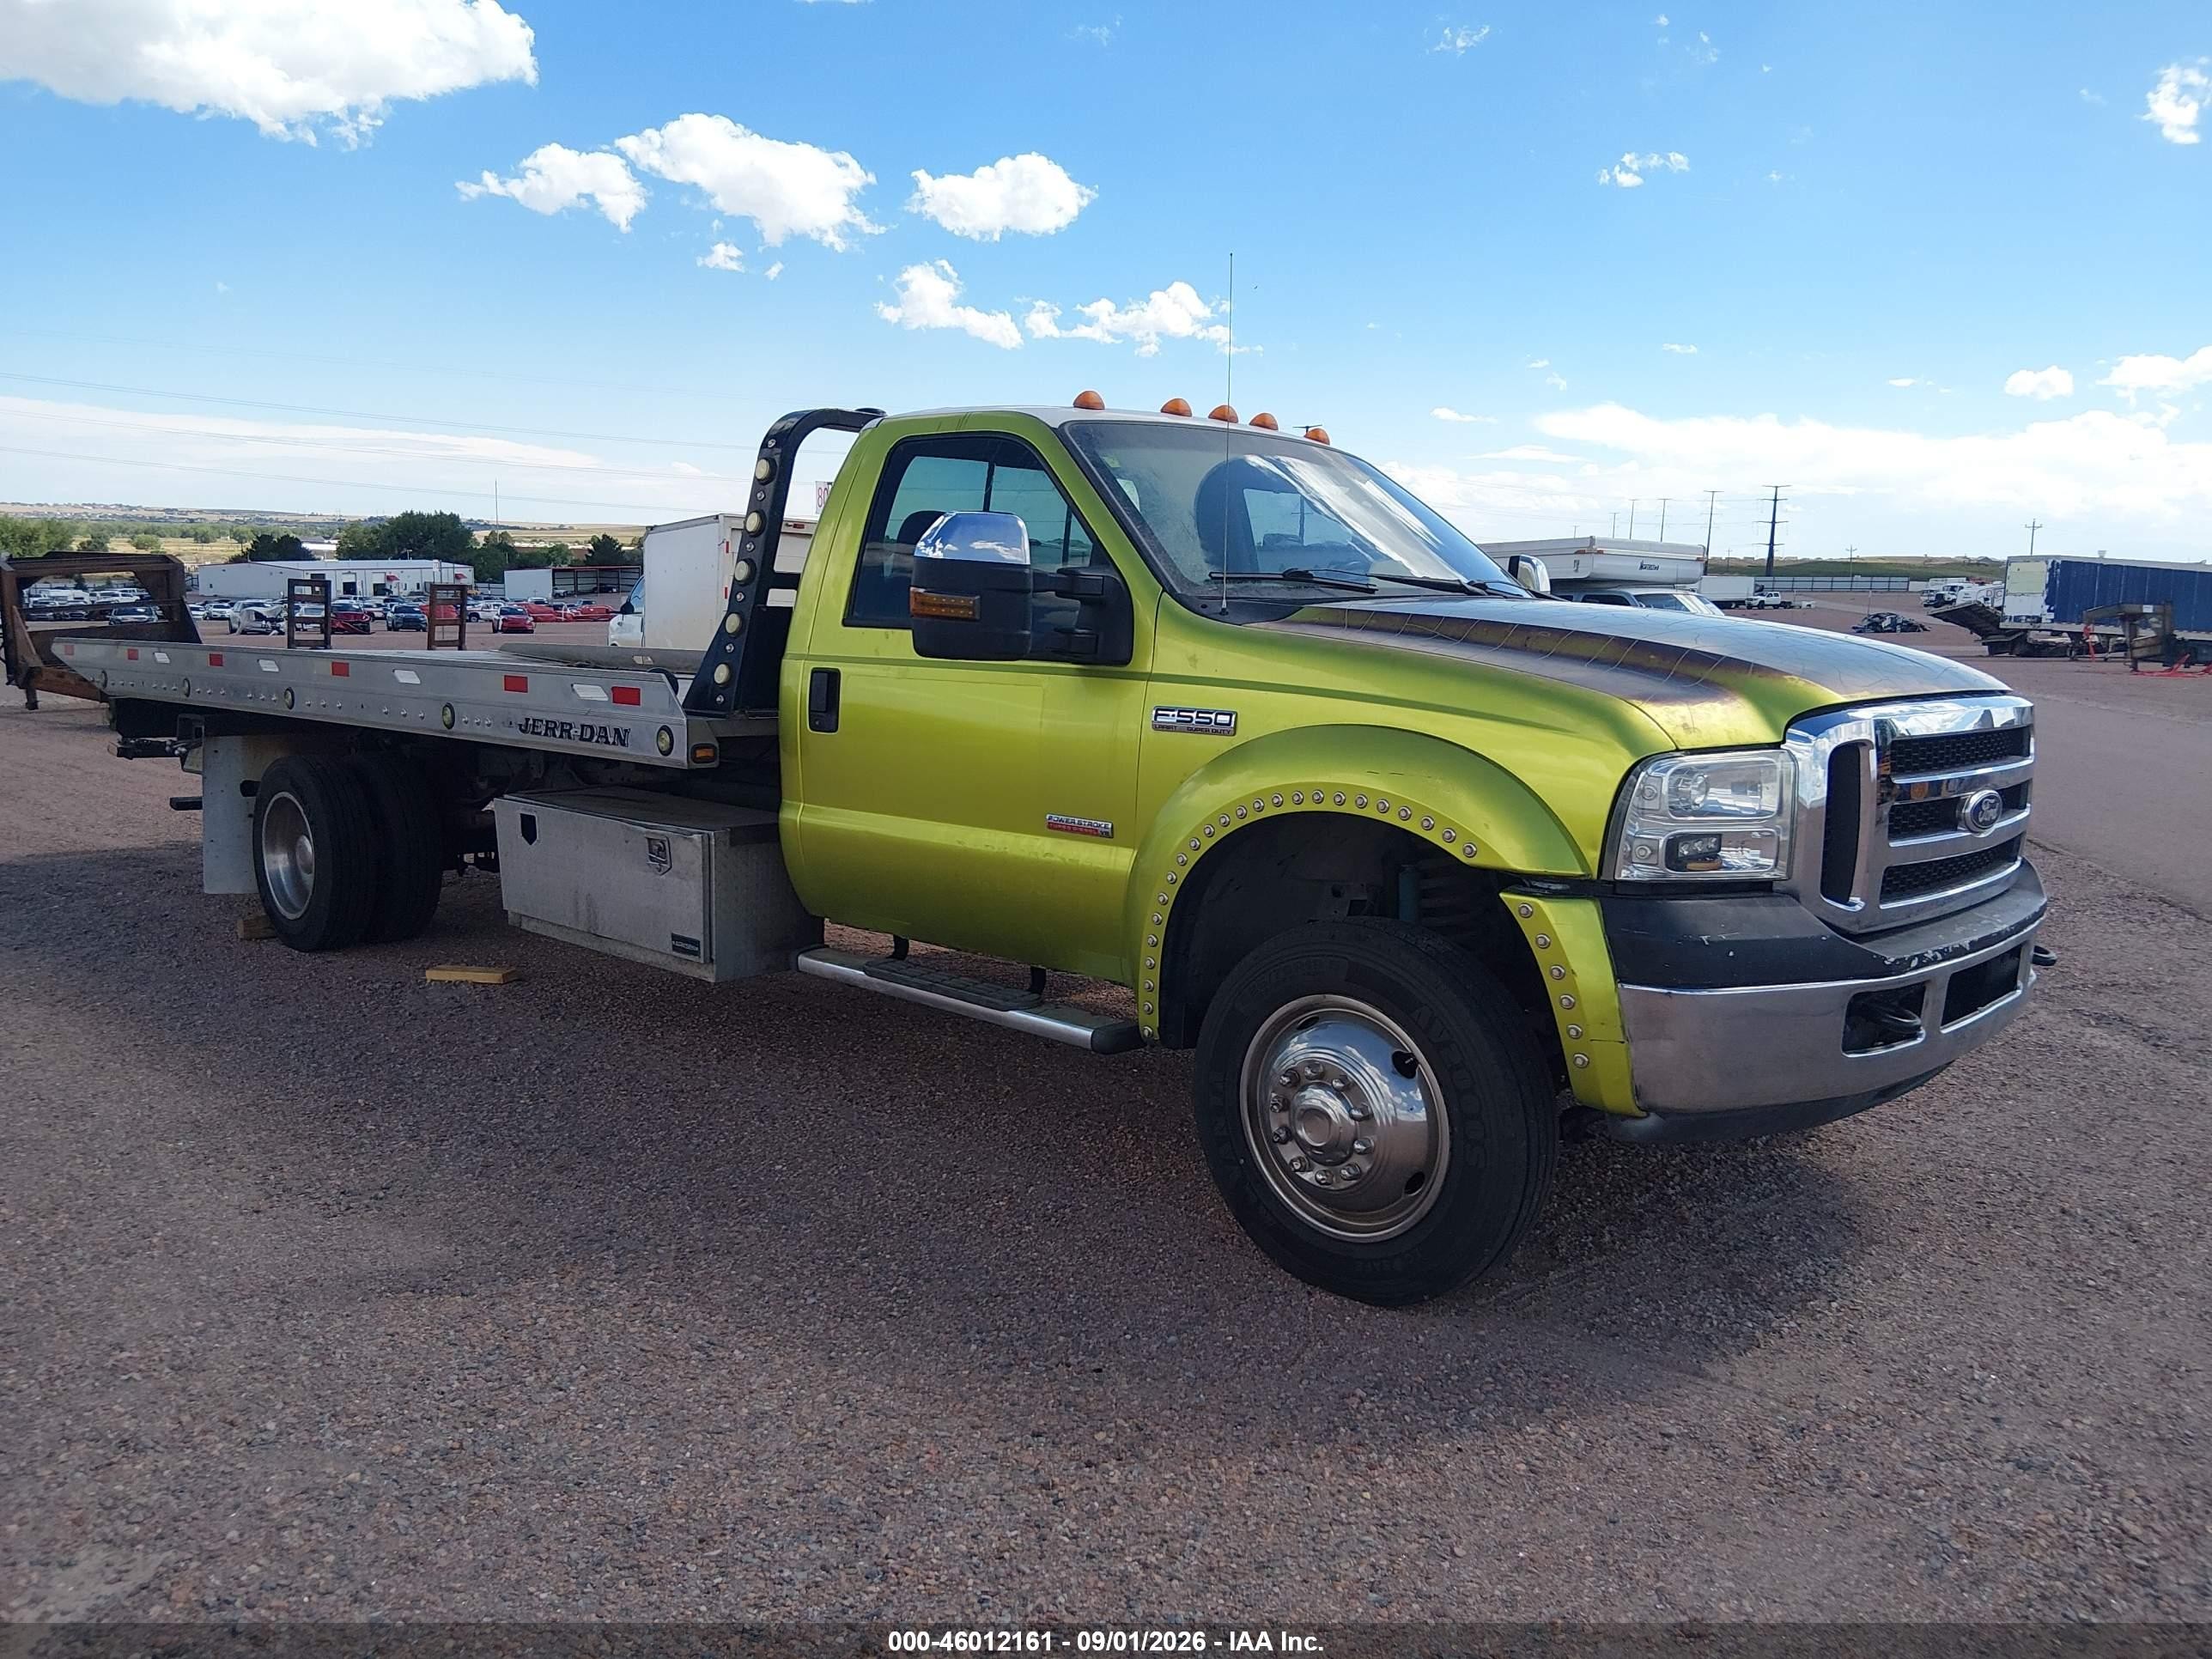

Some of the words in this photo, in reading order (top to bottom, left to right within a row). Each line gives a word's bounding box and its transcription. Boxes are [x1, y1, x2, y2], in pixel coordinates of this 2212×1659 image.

[518, 717, 631, 747] JERR-DAN
[1048, 815, 1076, 825] POWER
[1077, 820, 1110, 830] STROKE
